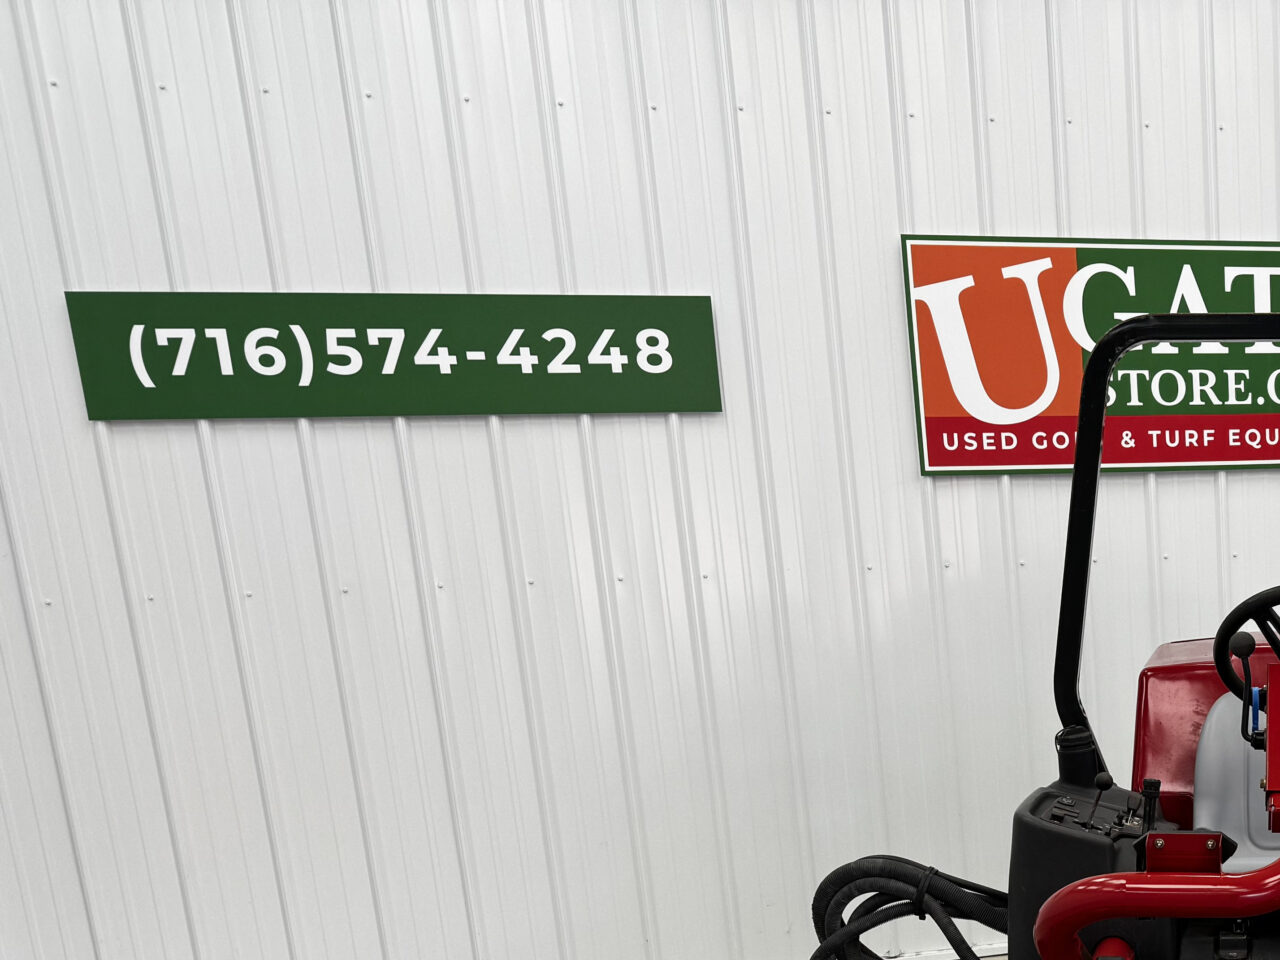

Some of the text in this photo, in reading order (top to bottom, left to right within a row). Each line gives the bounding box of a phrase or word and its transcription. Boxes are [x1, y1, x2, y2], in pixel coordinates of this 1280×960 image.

[128, 323, 674, 388] (716)574-4248
[942, 432, 1018, 451] USED
[1031, 430, 1078, 450] GO
[1120, 430, 1136, 448] &
[1148, 429, 1216, 447] TURF
